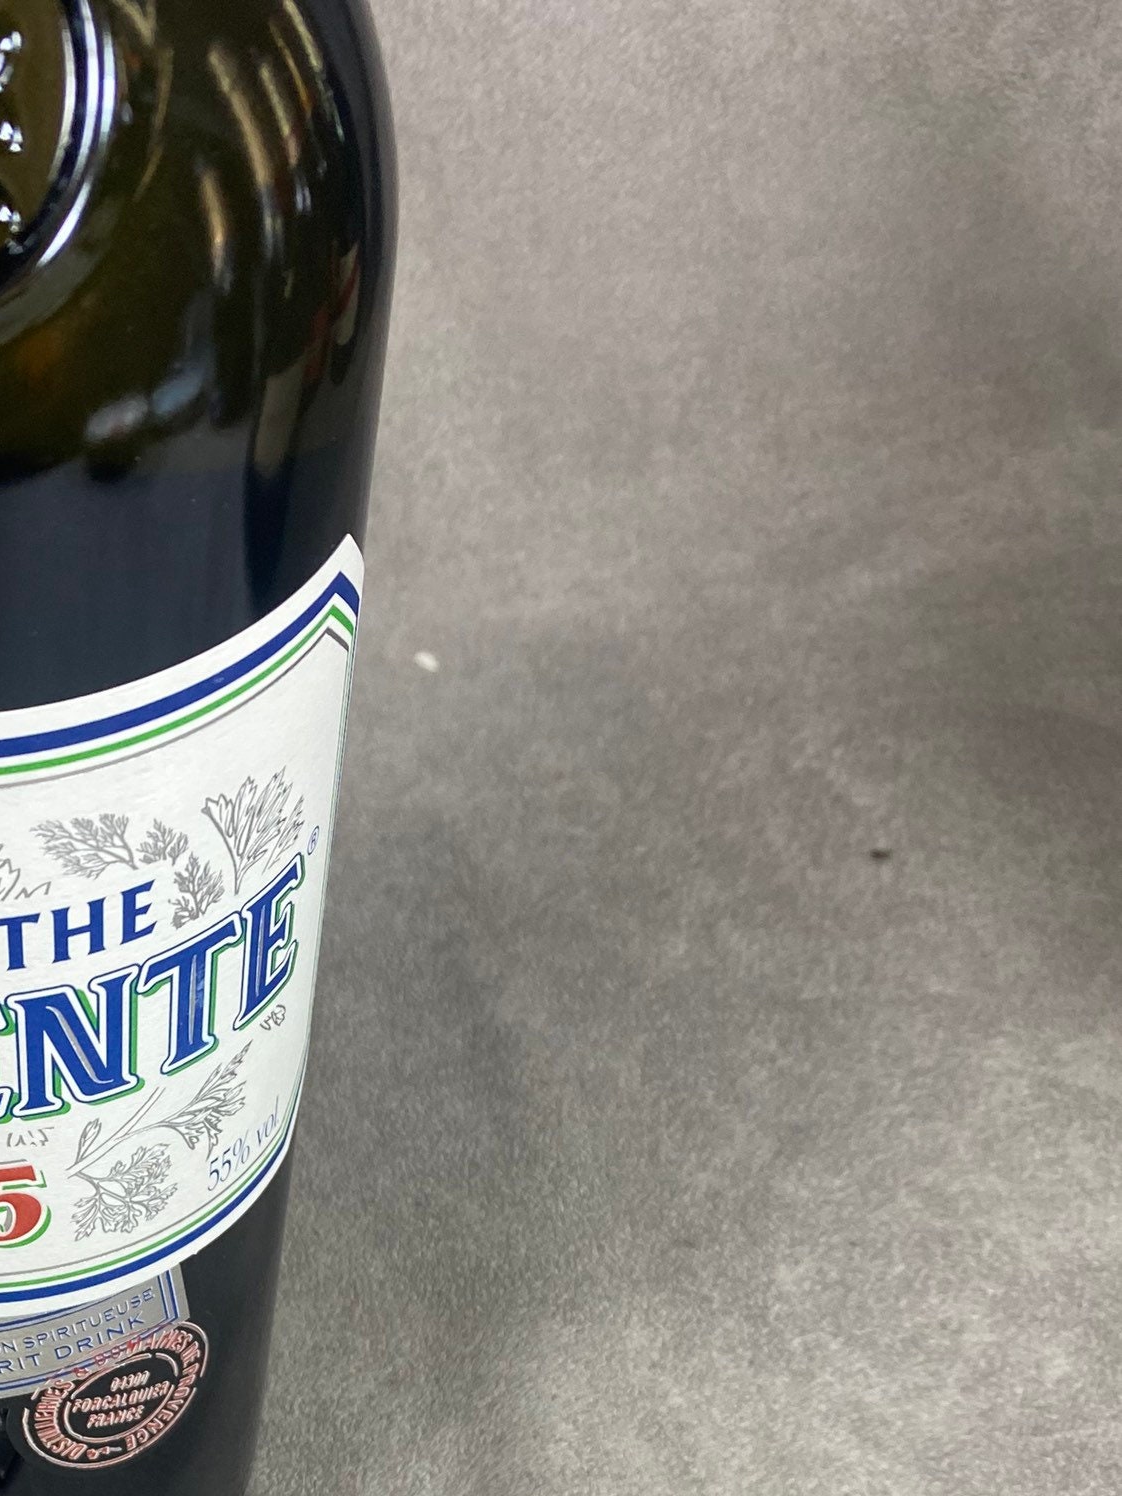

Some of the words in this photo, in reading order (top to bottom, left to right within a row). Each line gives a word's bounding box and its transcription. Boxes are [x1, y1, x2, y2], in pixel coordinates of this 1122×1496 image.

[207, 1128, 251, 1192] 55%
[22, 1286, 157, 1350] SPIRITUEUSE
[53, 1312, 147, 1361] DRINK
[71, 1379, 171, 1414] FORCALQUIER
[86, 1404, 146, 1430] FRANCE
[124, 1361, 201, 1451] PROVENCE
